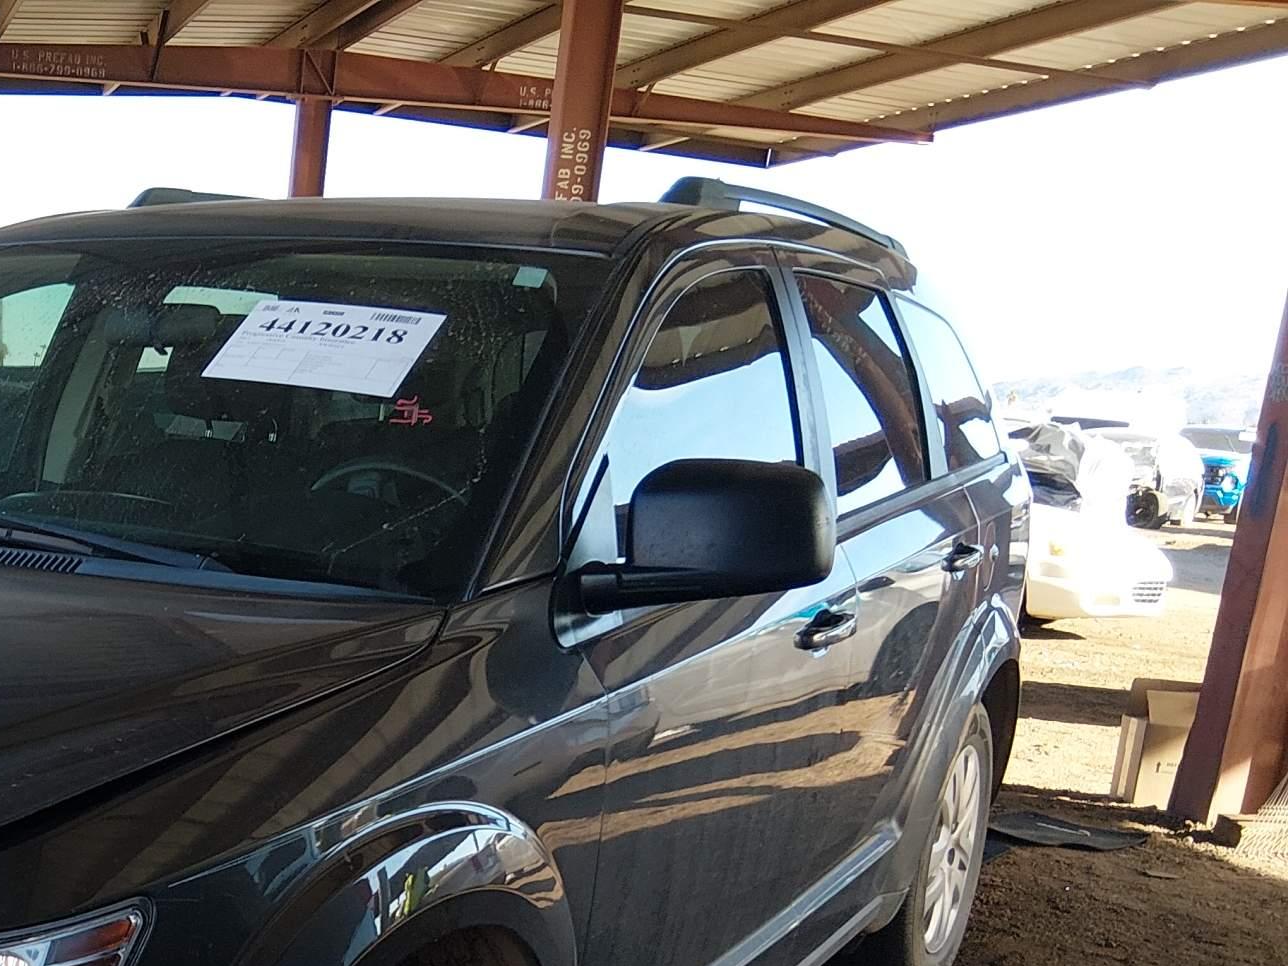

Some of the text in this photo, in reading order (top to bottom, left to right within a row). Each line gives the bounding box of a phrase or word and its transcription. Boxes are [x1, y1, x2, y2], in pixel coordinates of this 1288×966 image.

[86, 54, 107, 67] INC.
[519, 86, 541, 98] U.S.
[560, 127, 577, 159] INC.
[259, 318, 408, 345] 44120218
